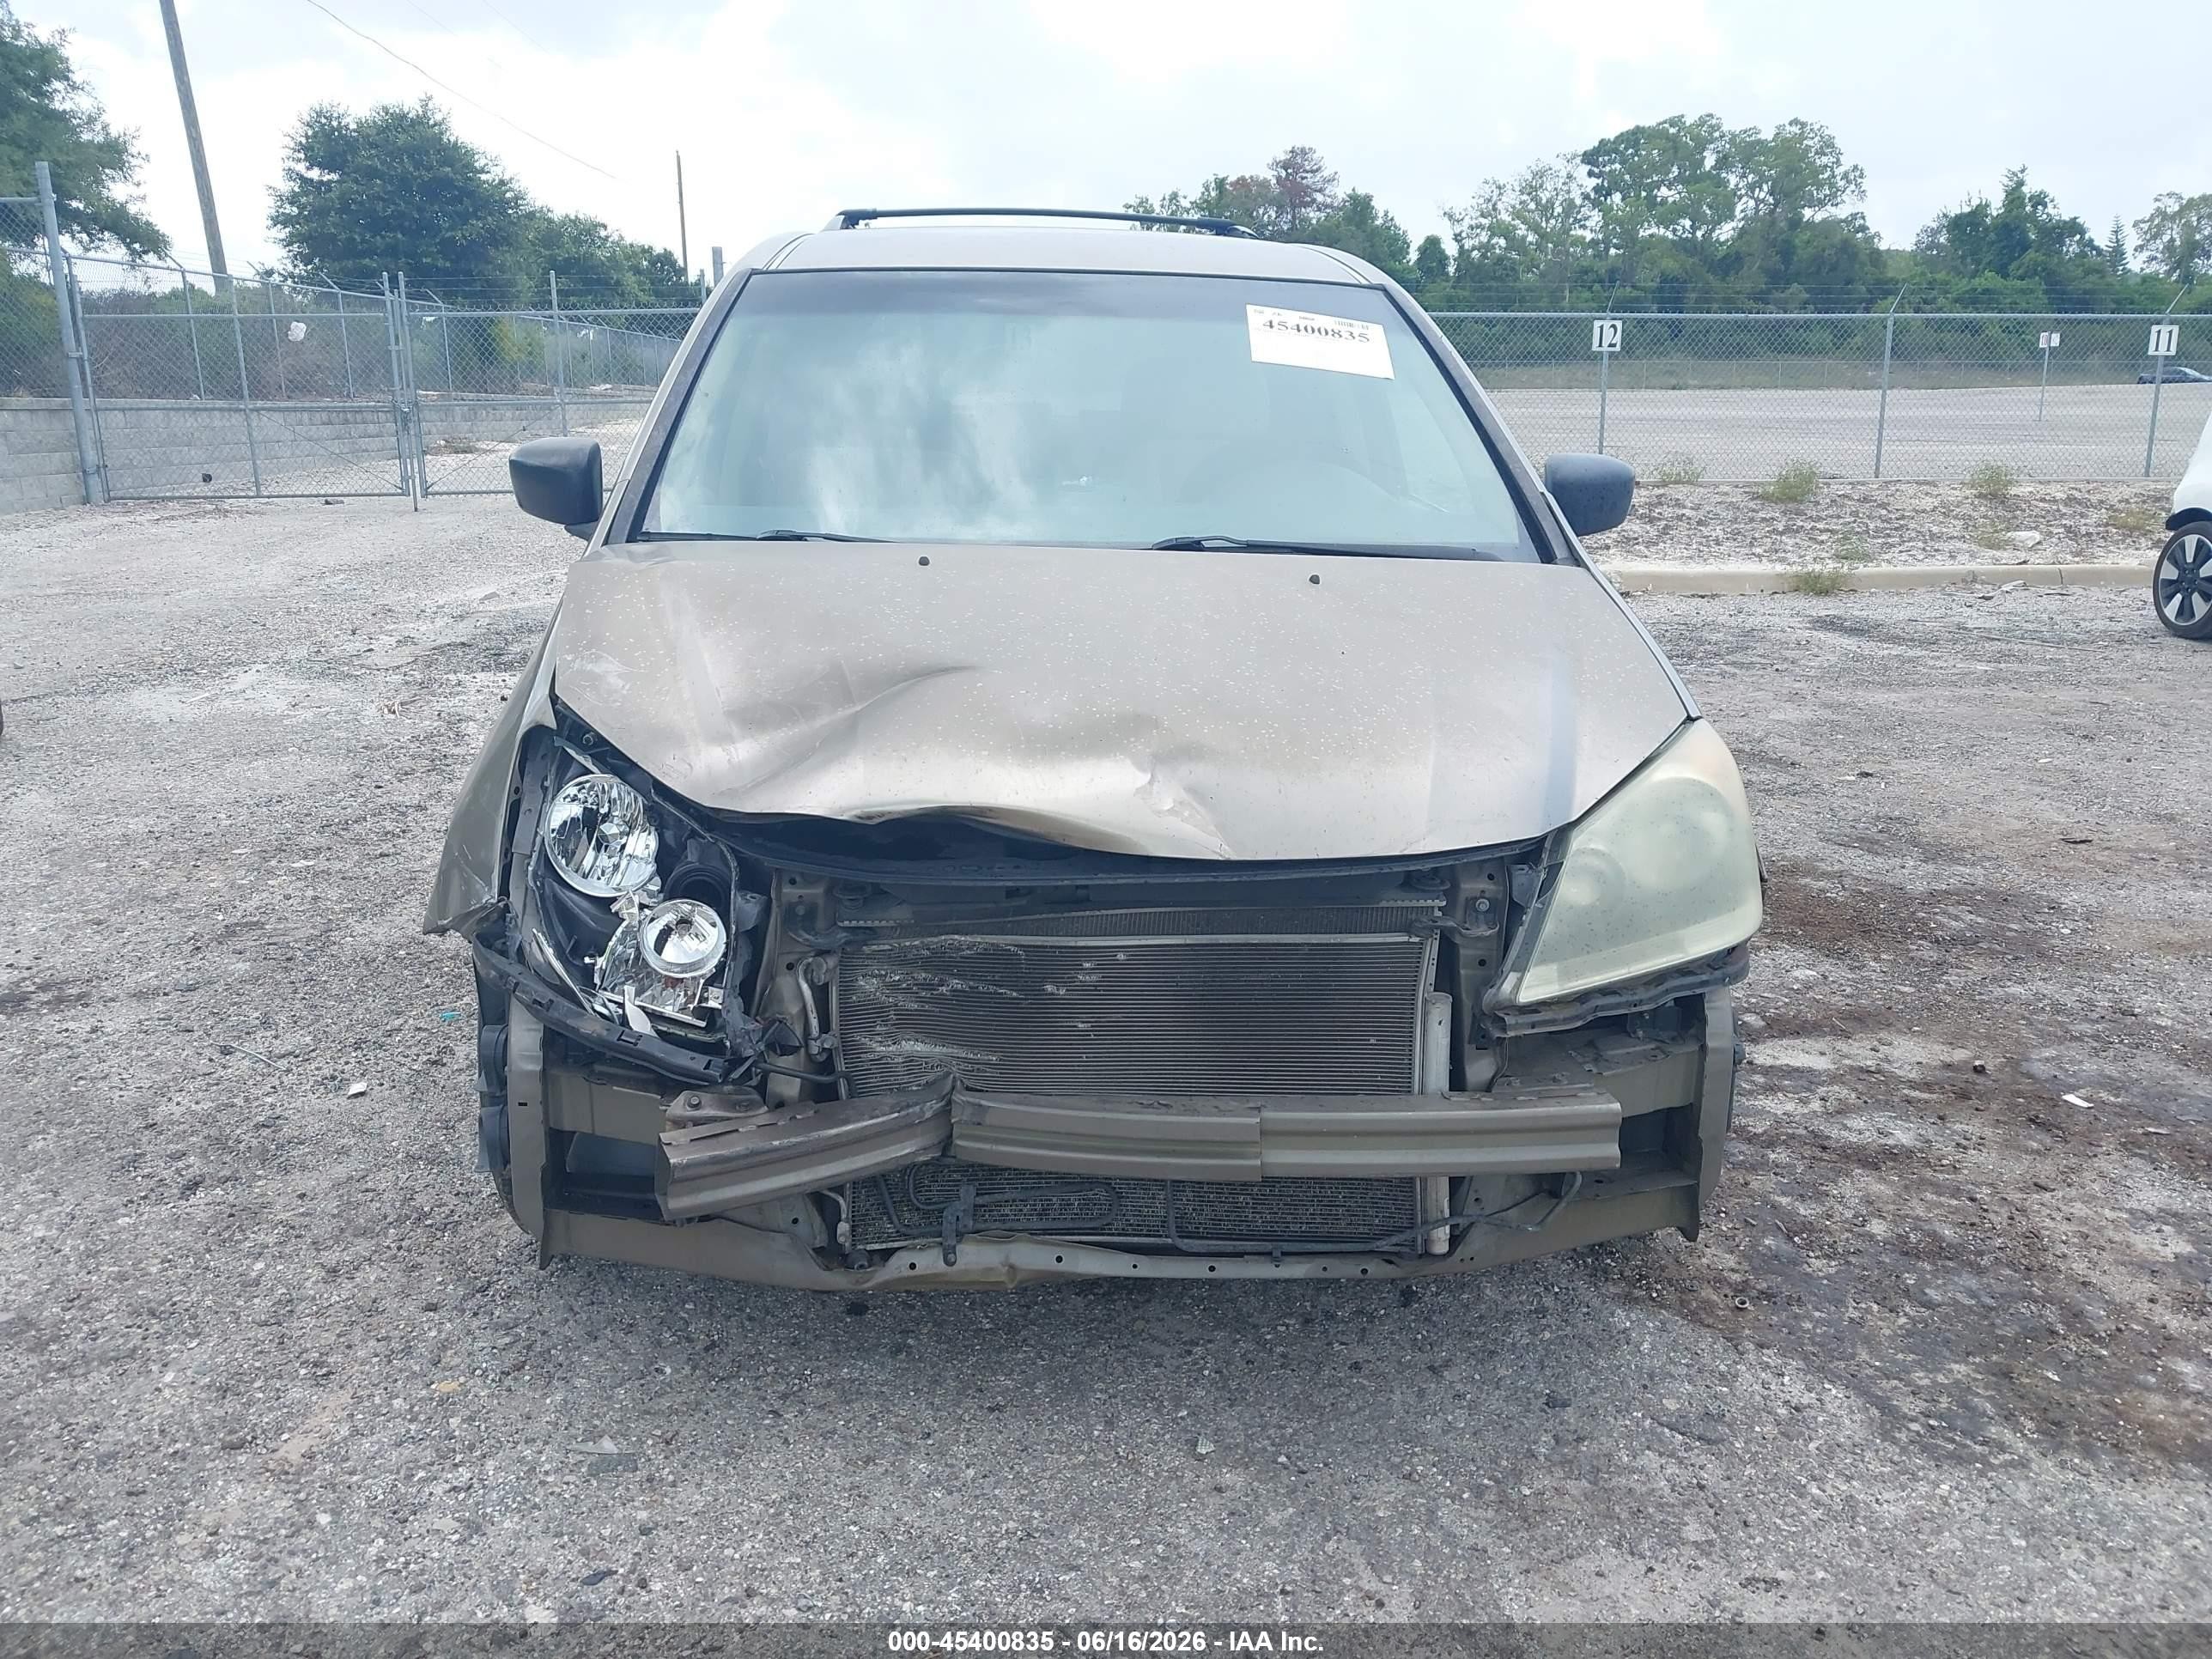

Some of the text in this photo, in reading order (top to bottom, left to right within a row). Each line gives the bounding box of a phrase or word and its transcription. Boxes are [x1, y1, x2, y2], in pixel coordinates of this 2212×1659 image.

[1262, 319, 1370, 343] 45400835
[1595, 323, 1619, 348] 12
[2152, 328, 2174, 352] 11
